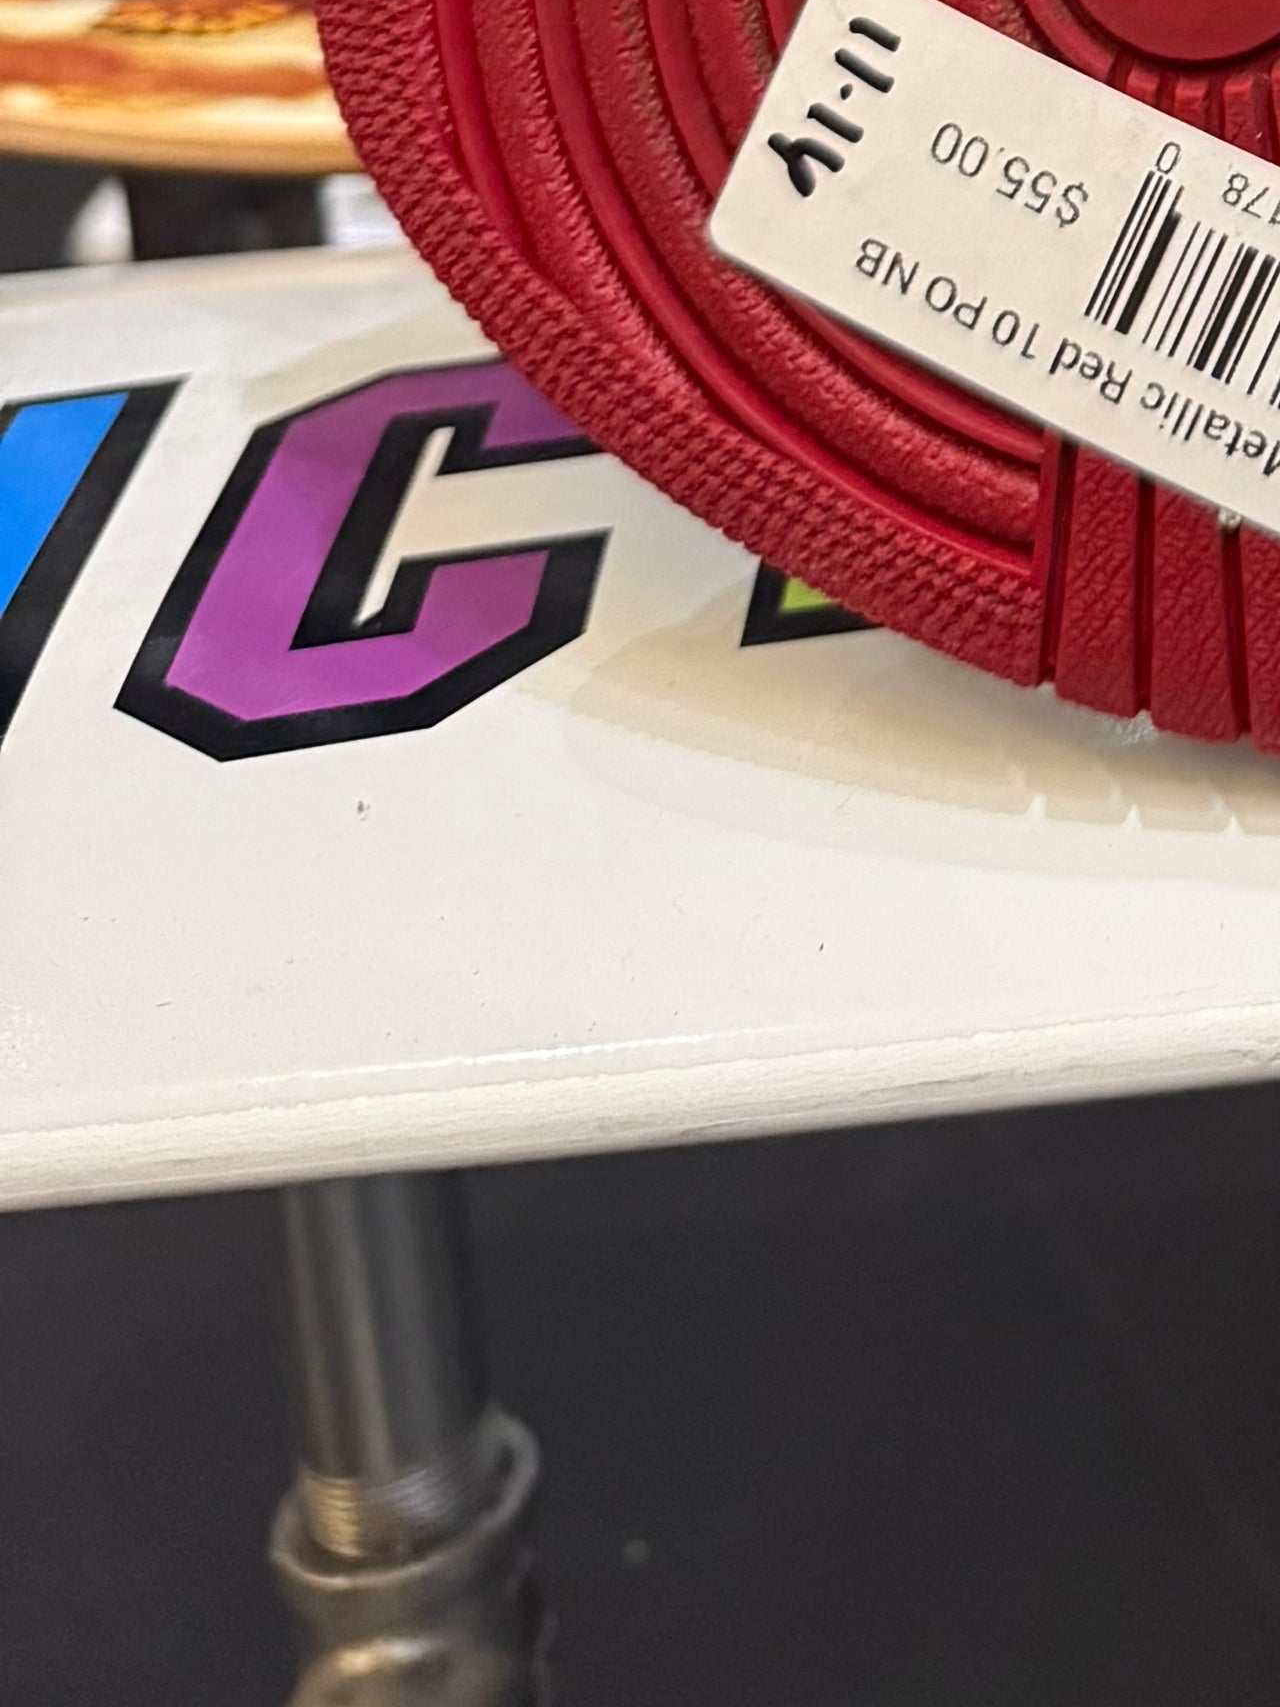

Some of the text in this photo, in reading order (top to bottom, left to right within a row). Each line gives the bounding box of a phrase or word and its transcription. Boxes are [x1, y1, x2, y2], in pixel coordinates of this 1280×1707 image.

[930, 122, 1089, 228] $55.00
[1155, 141, 1181, 175] 0
[855, 238, 920, 295] NB
[924, 276, 987, 331] PO
[992, 310, 1040, 359] 10
[1048, 337, 1133, 405] Red
